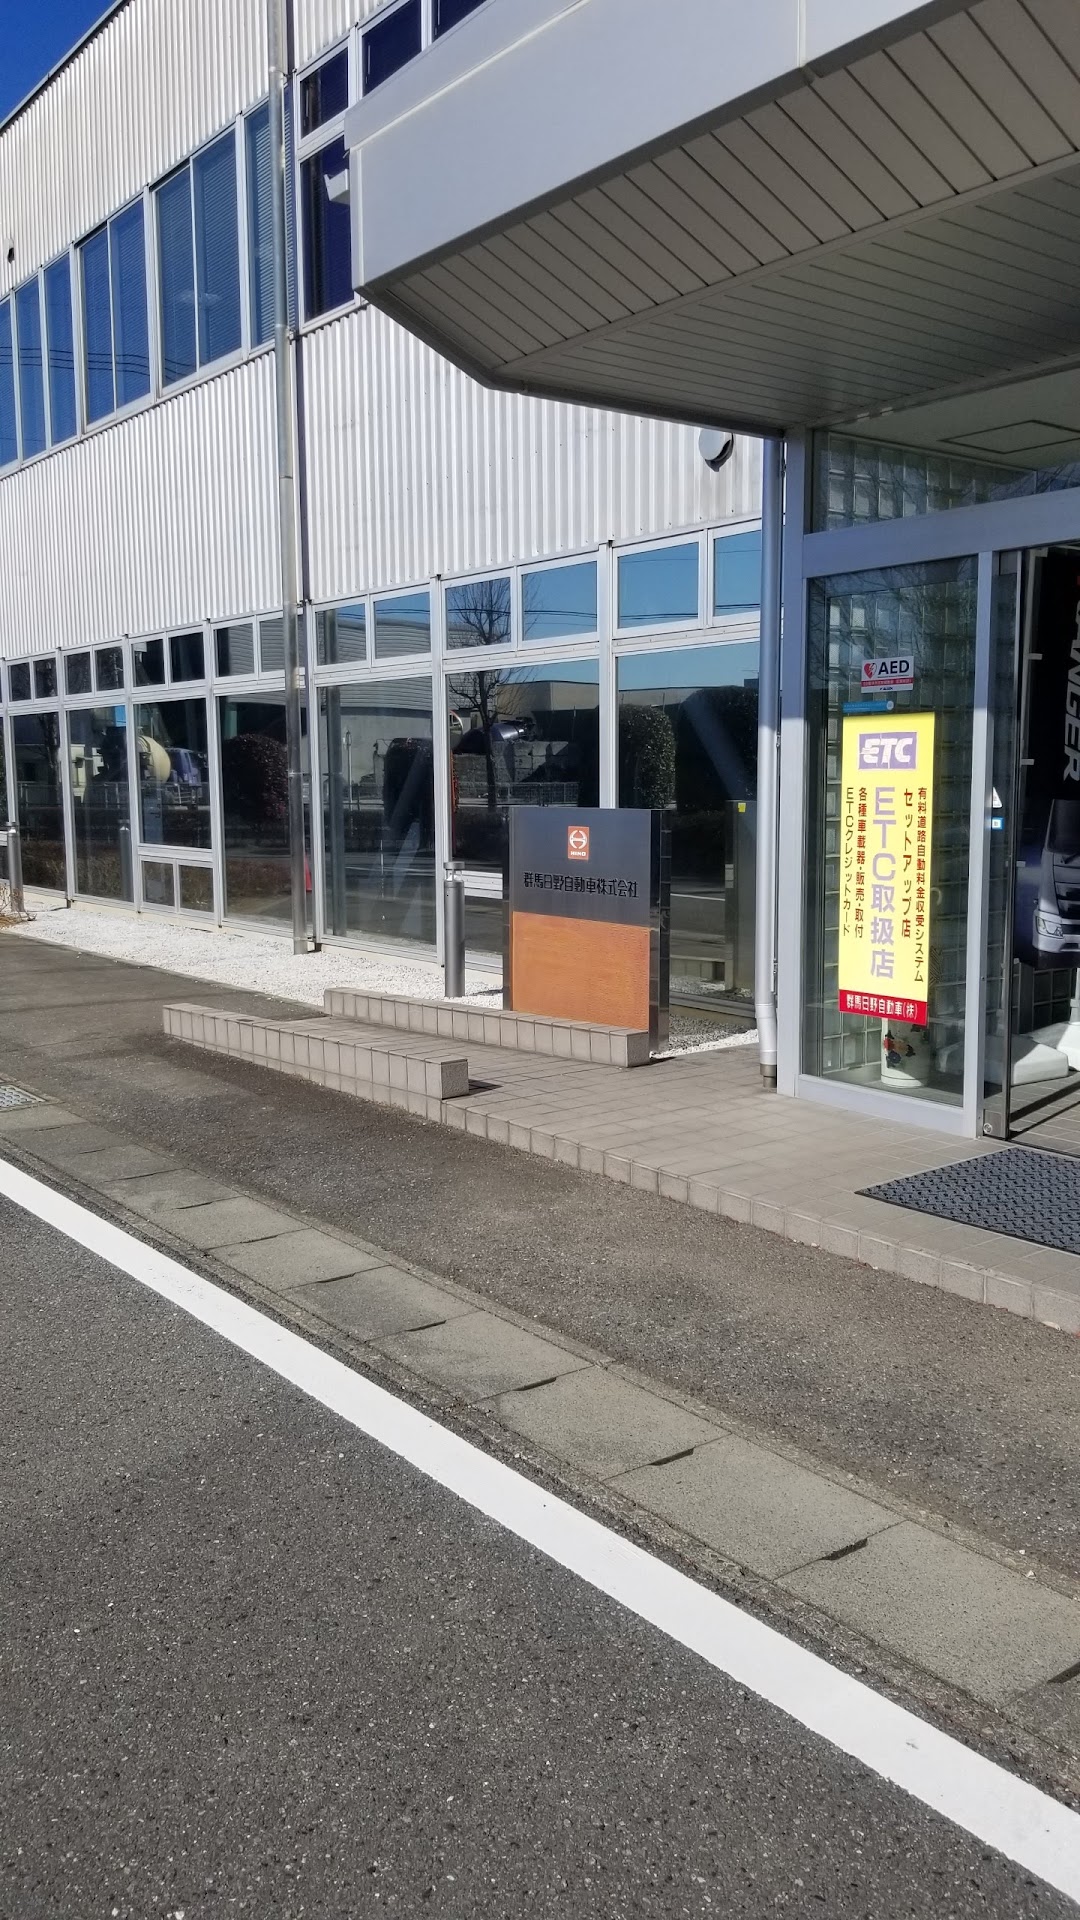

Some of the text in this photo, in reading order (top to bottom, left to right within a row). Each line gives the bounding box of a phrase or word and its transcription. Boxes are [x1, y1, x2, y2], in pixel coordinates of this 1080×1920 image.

[877, 660, 910, 675] AED
[860, 737, 913, 764] ETC
[523, 871, 639, 898] 群馬日野自動車株式会社
[843, 787, 854, 937] ETCクレジットカード
[855, 787, 868, 938] 各種車載器・販売・取付
[871, 787, 897, 979] ETC取扱店
[901, 788, 913, 939] セットアップ店
[914, 787, 928, 982] 有料道路自動料金収受システム
[846, 993, 918, 1020] 群馬日野自動車(株)
